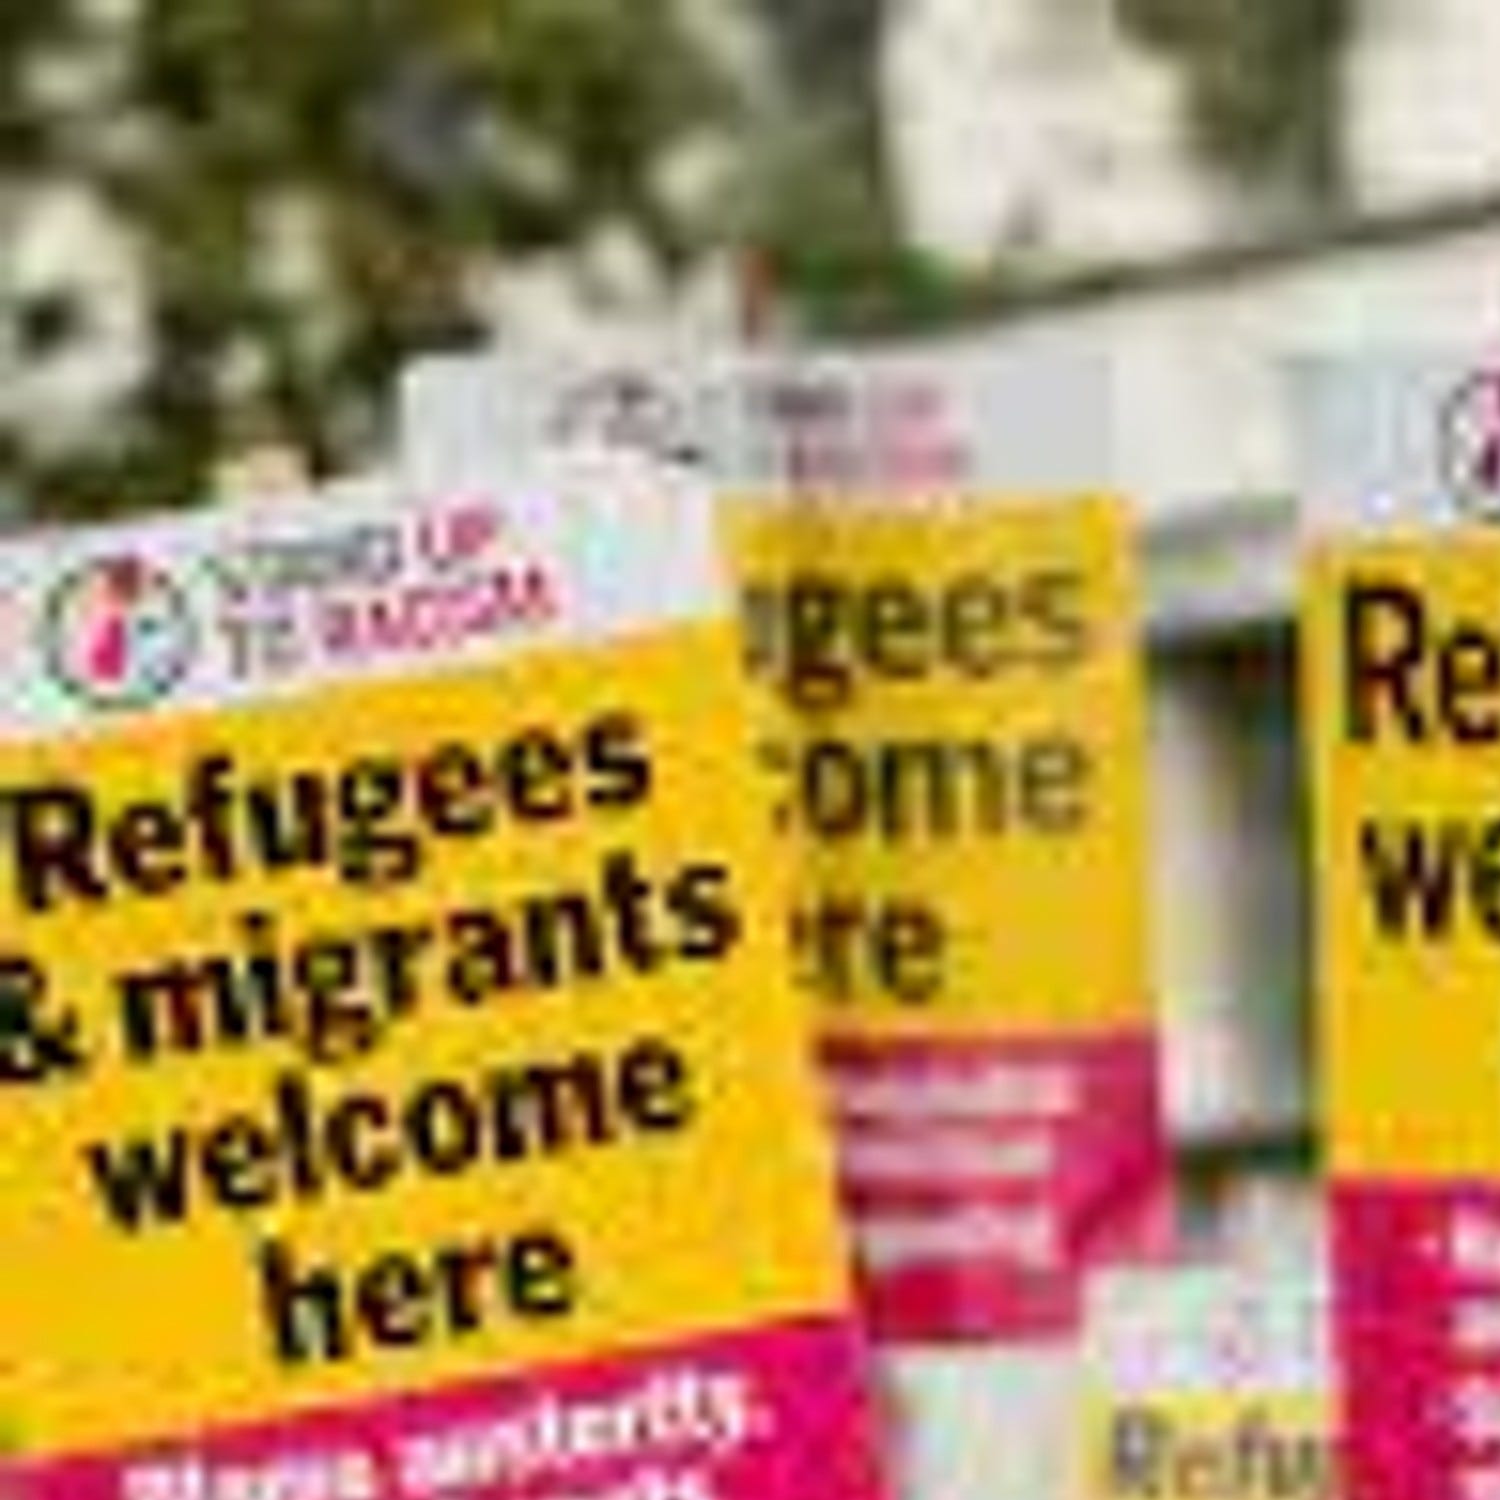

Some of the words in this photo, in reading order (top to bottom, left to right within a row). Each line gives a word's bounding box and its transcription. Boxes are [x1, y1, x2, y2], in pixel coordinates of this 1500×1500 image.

[744, 568, 1084, 712] gees
[4, 717, 650, 912] Refugees
[0, 956, 84, 1084] &
[115, 852, 738, 1066] migrants
[87, 1037, 692, 1234] welcome
[258, 1231, 573, 1364] here
